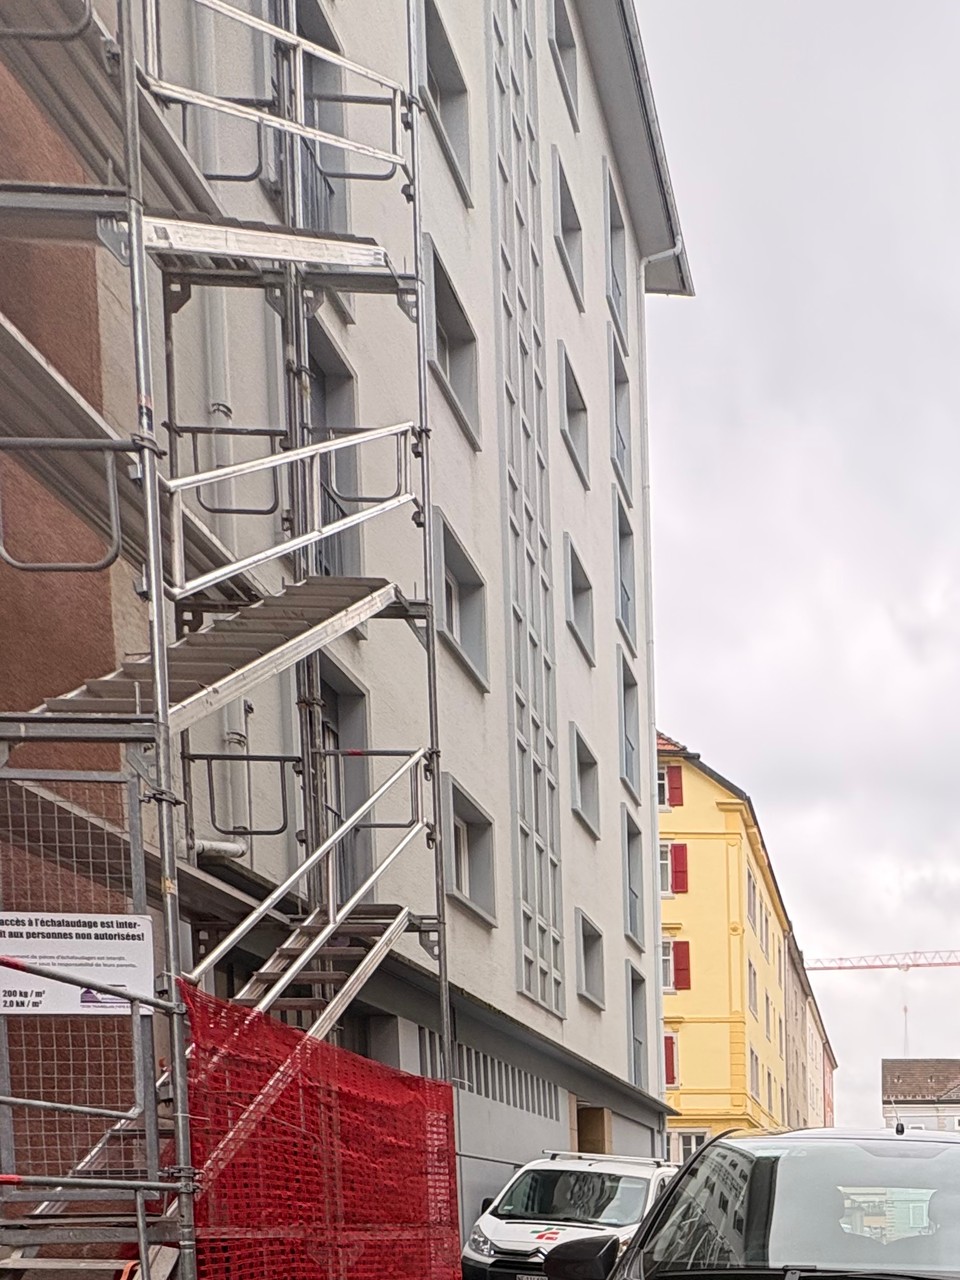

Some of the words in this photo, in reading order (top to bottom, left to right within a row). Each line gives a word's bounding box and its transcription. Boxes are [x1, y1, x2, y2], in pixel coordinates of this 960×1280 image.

[28, 918, 33, 927] à
[100, 921, 114, 929] est
[116, 920, 141, 929] inter-
[26, 932, 73, 940] personnes
[94, 932, 145, 941] autorisées!
[2, 990, 17, 998] 200
[19, 990, 28, 999] kg
